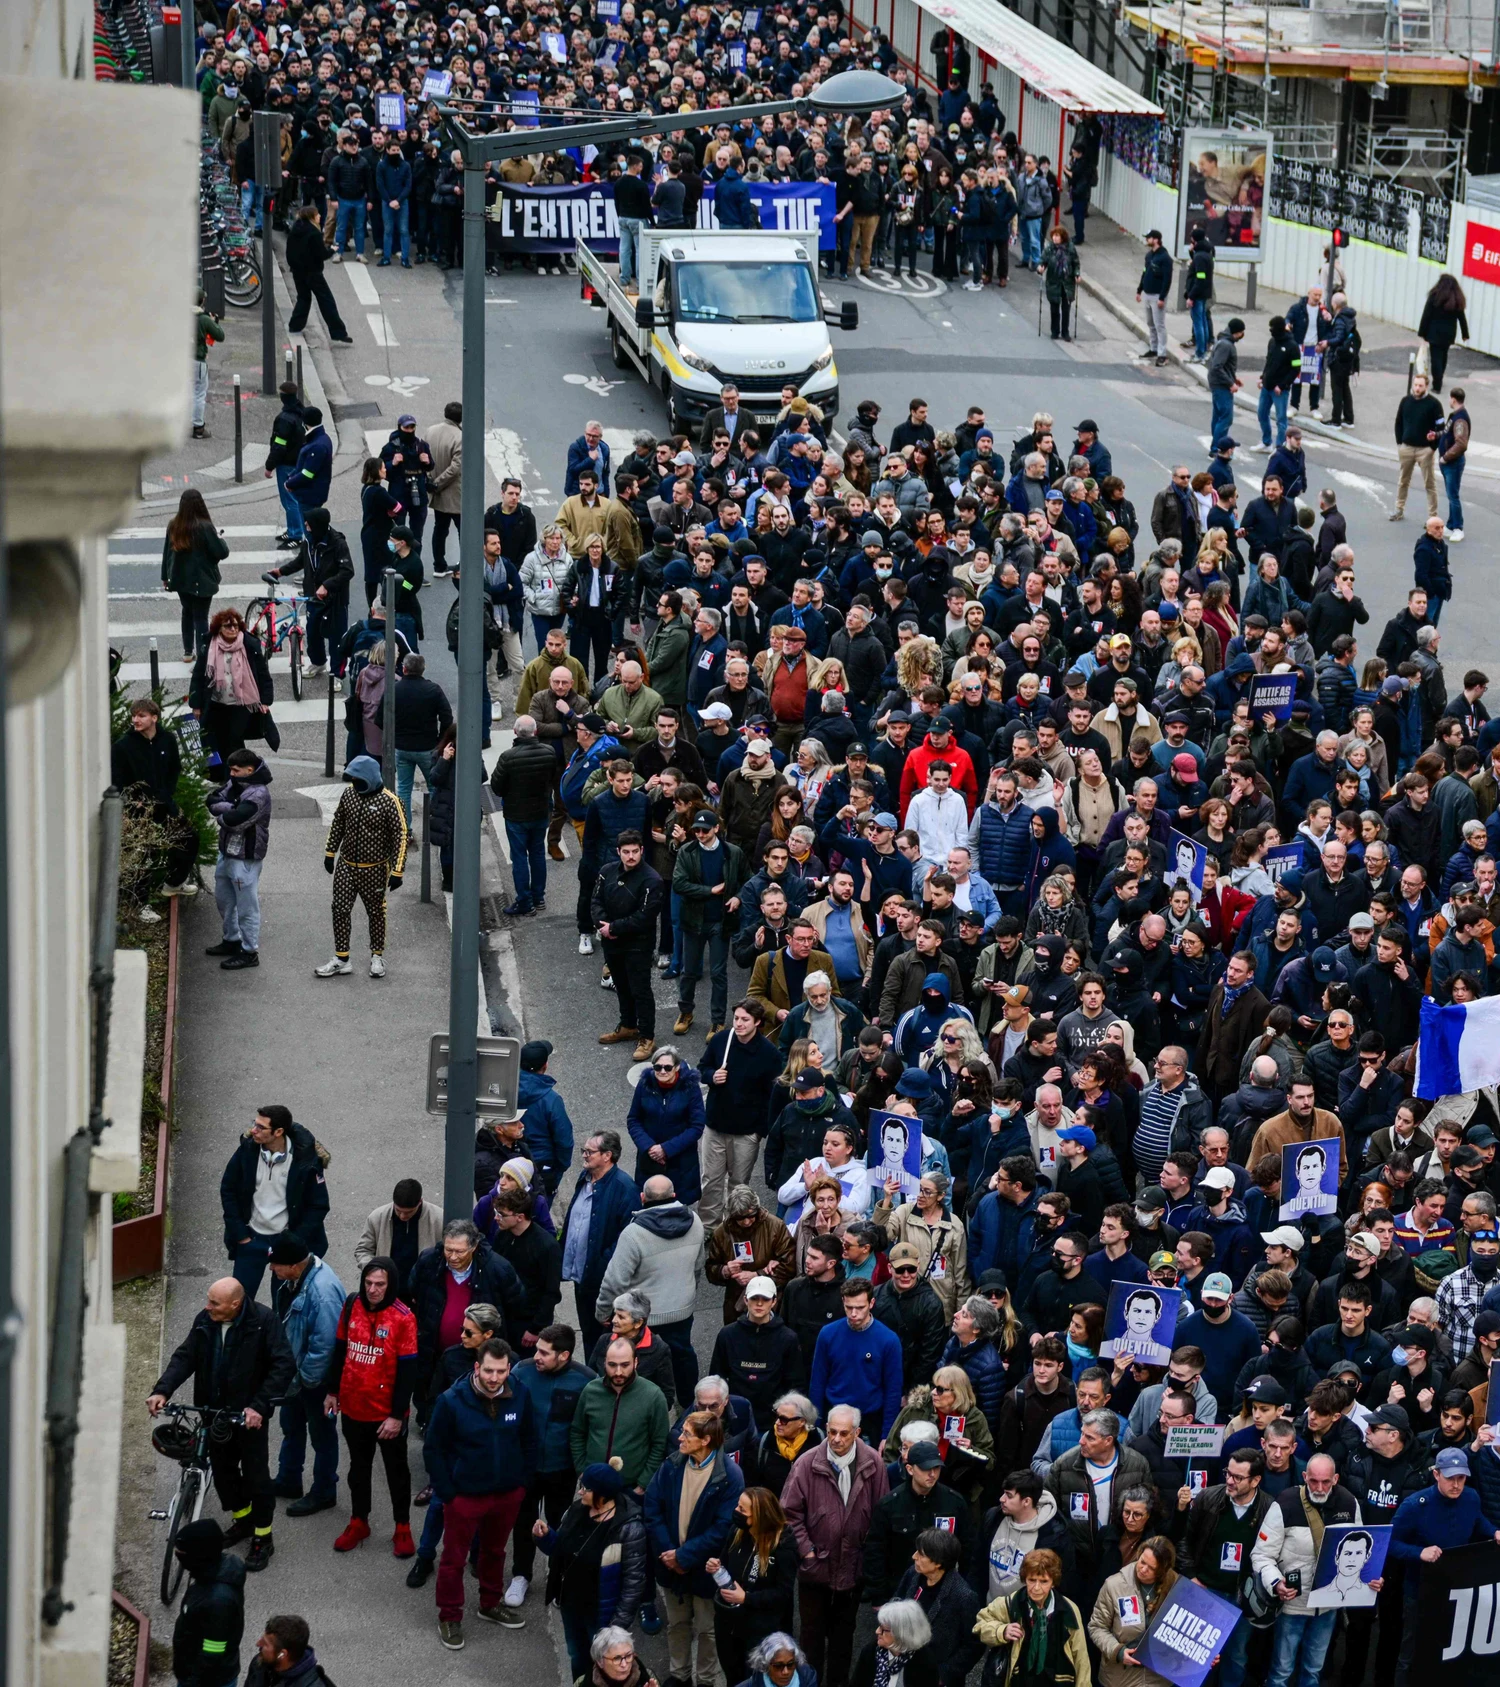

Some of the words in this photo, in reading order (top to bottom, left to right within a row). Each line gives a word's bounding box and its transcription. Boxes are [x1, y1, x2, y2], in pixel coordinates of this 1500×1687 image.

[772, 198, 822, 232] TUE
[744, 359, 786, 369] IVECO
[1255, 685, 1291, 698] ANTIFAS
[1253, 697, 1289, 707] ASSASSINS
[876, 1165, 911, 1186] QUENTIN
[1290, 1193, 1328, 1213] QUENTIN
[1112, 1337, 1160, 1357] QUENTIN
[355, 1353, 377, 1365] BETTER
[505, 1413, 517, 1421] HH
[1172, 1427, 1218, 1436] QUENTIN,
[1367, 1489, 1398, 1505] FRANCE
[1162, 1603, 1222, 1649] ANTIFAS
[1153, 1622, 1211, 1666] ASSASSINS
